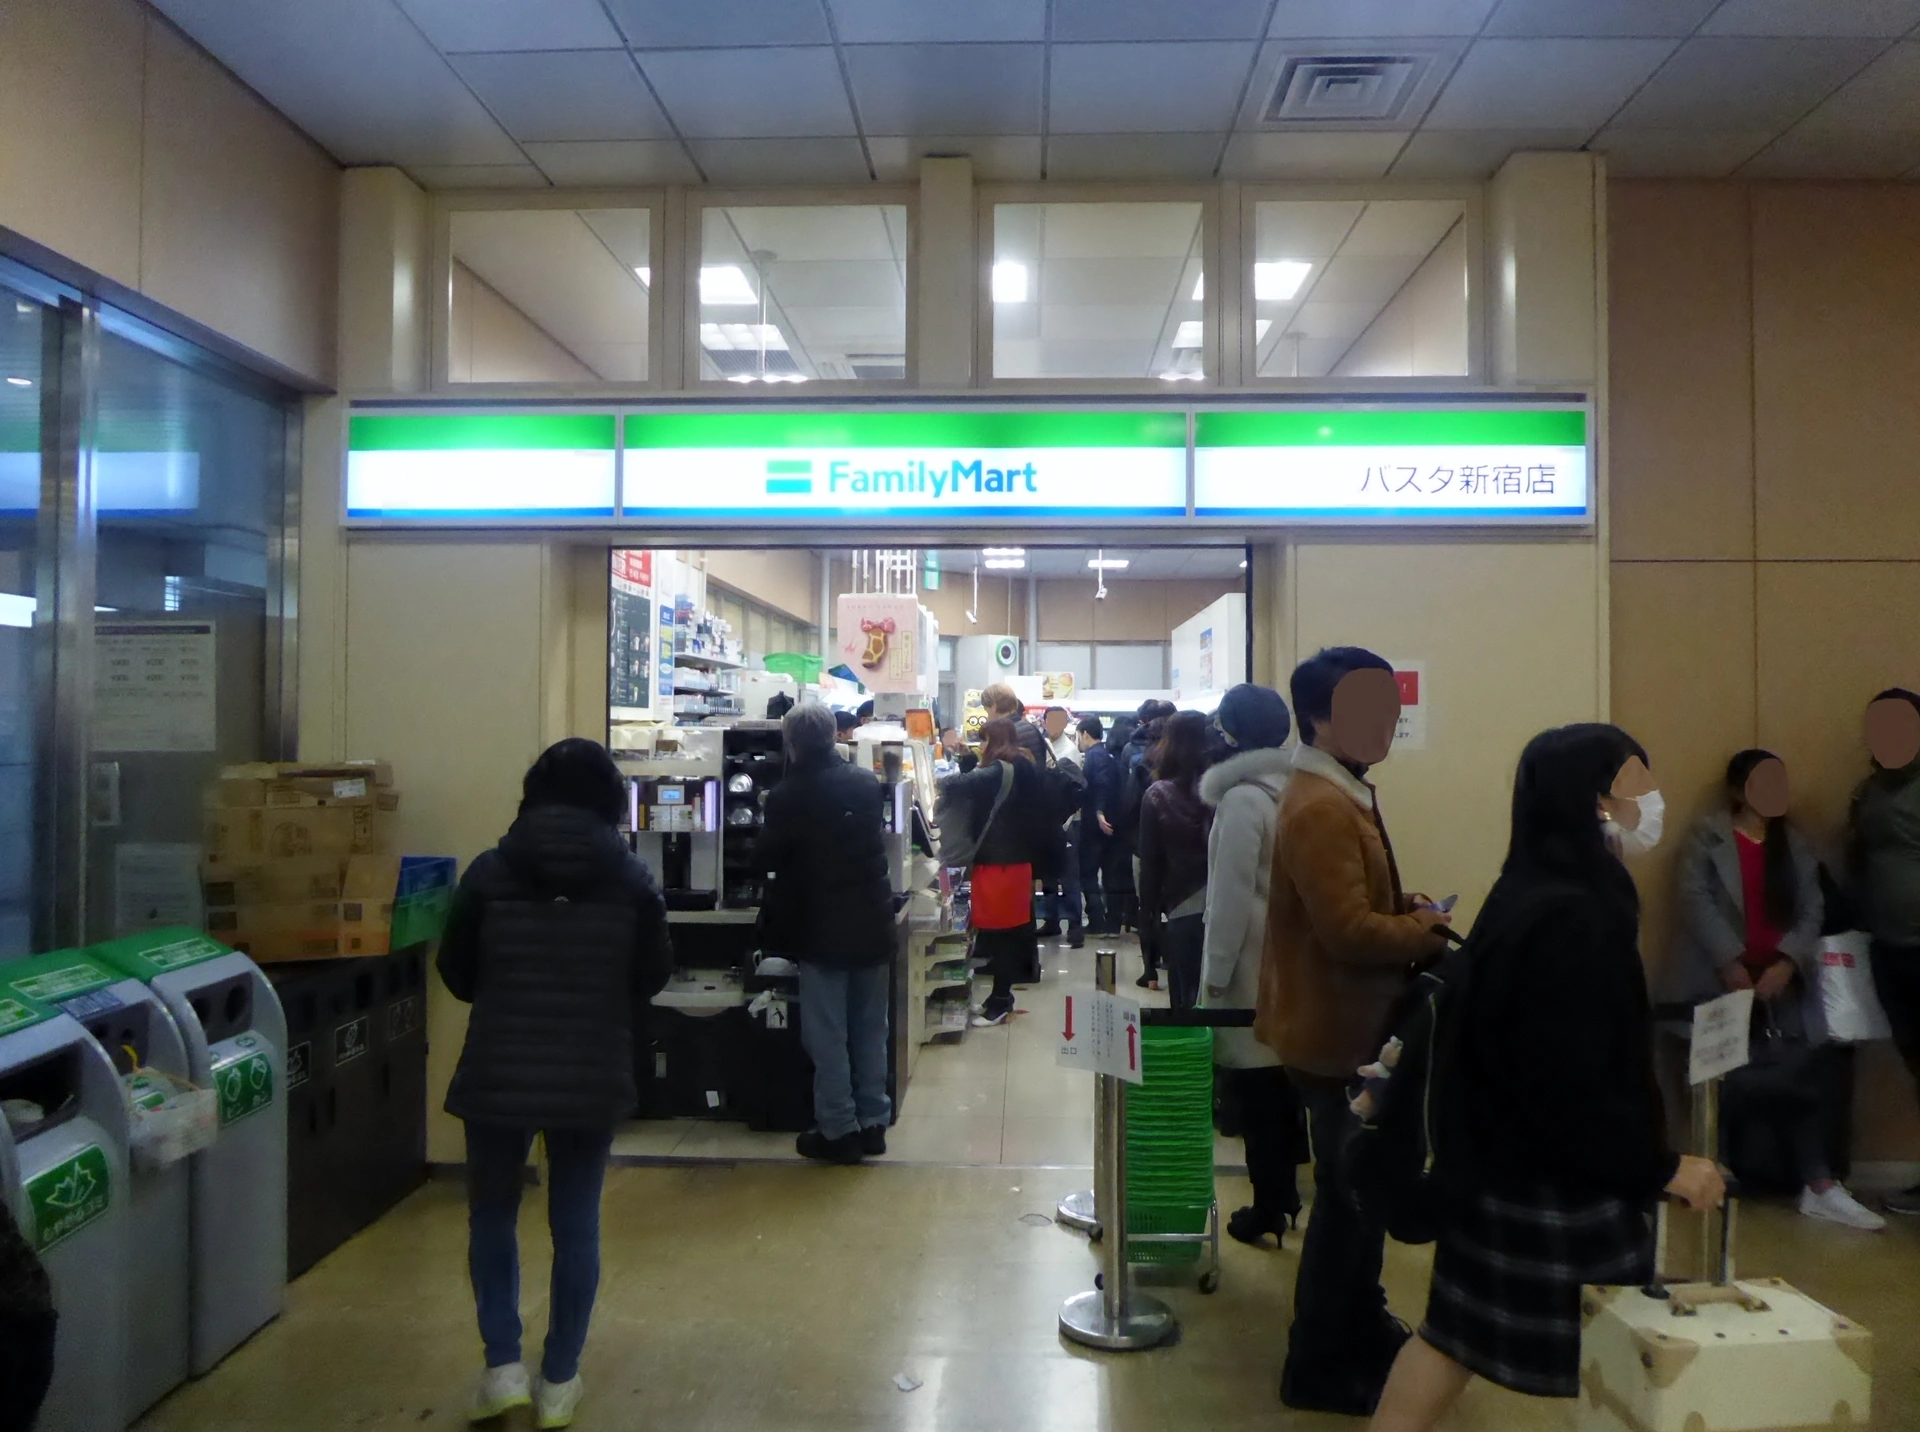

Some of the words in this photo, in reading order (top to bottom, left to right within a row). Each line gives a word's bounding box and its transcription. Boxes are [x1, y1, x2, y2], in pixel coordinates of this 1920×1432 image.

[829, 459, 1038, 498] FamilyMart
[1360, 463, 1556, 494] バスタ新宿店
[1061, 1046, 1077, 1055] 出口
